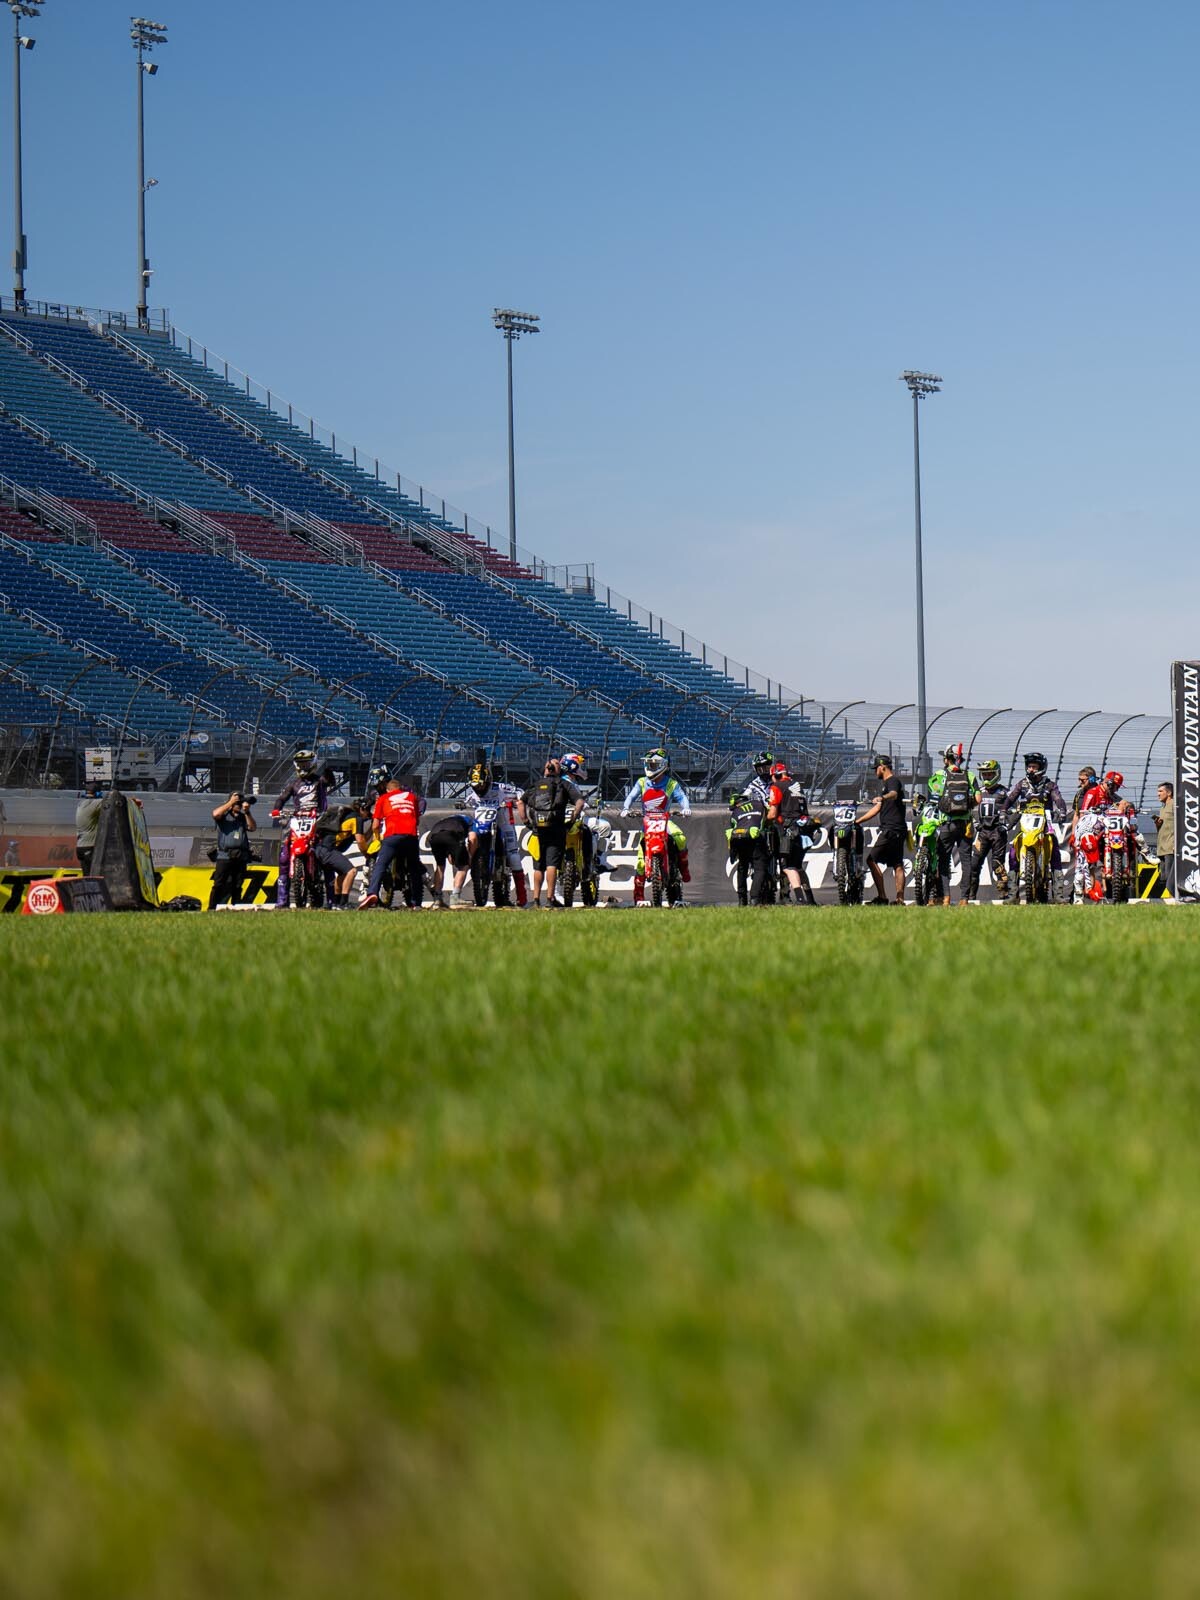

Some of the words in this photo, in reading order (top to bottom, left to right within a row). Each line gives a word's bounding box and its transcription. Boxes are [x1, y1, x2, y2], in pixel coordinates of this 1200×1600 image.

[1182, 664, 1199, 788] MOUNTAIN
[476, 810, 497, 820] 78
[835, 808, 855, 819] 46
[984, 804, 990, 815] 1
[296, 821, 312, 832] 15
[647, 820, 665, 832] 23
[1109, 817, 1124, 830] 51
[1182, 790, 1199, 866] ROCKY
